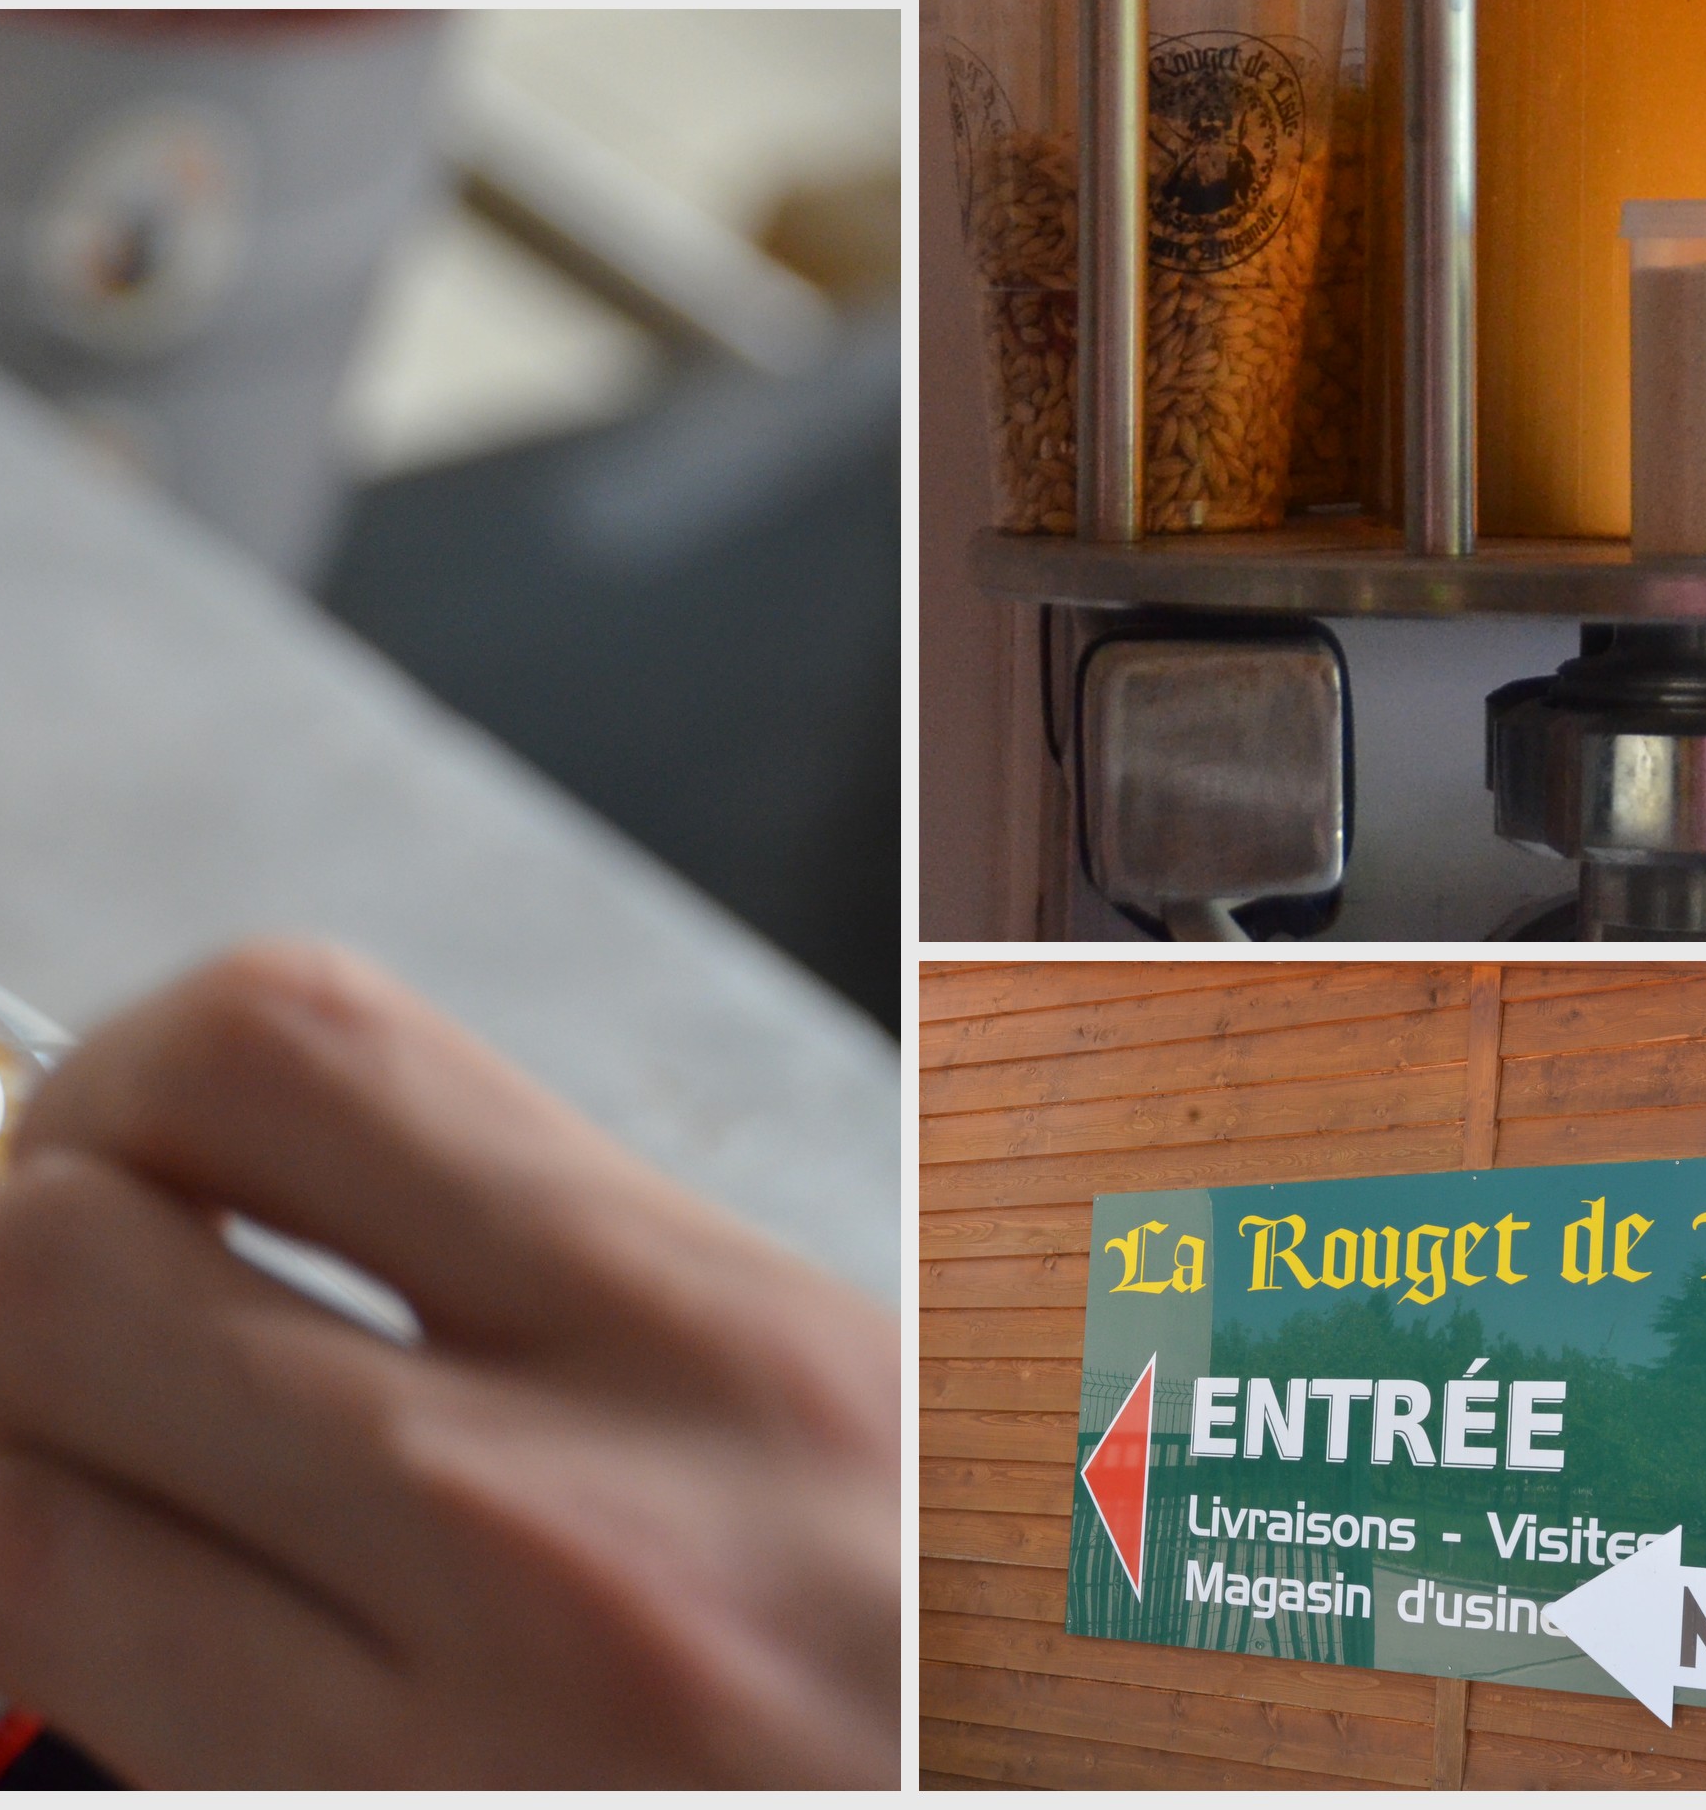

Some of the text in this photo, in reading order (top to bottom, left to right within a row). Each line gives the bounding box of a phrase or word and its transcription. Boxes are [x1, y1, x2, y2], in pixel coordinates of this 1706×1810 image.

[1104, 1220, 1206, 1294] La
[1238, 1213, 1531, 1305] Rouget
[1560, 1196, 1655, 1285] de
[1189, 1357, 1567, 1472] ENTRÉE
[1188, 1494, 1417, 1552] Livraisons
[1185, 1559, 1371, 1619] Magasin
